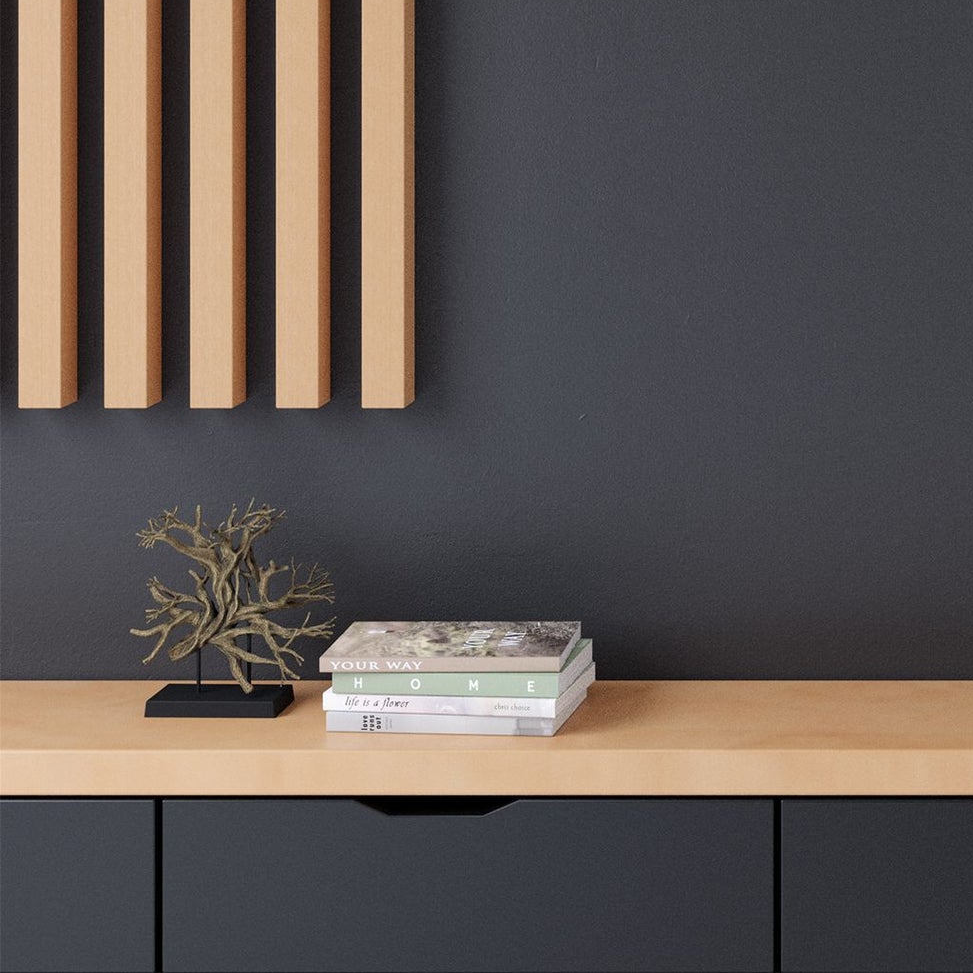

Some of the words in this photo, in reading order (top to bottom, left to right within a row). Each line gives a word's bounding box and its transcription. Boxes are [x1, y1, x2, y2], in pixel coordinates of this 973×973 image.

[461, 628, 495, 649] YOUR
[498, 631, 527, 647] WAY
[330, 661, 380, 670] YOUR
[386, 661, 422, 670] WAY
[354, 677, 535, 692] HOME
[344, 696, 359, 709] life
[362, 698, 370, 707] is
[380, 697, 409, 710] flower
[360, 715, 368, 731] love
